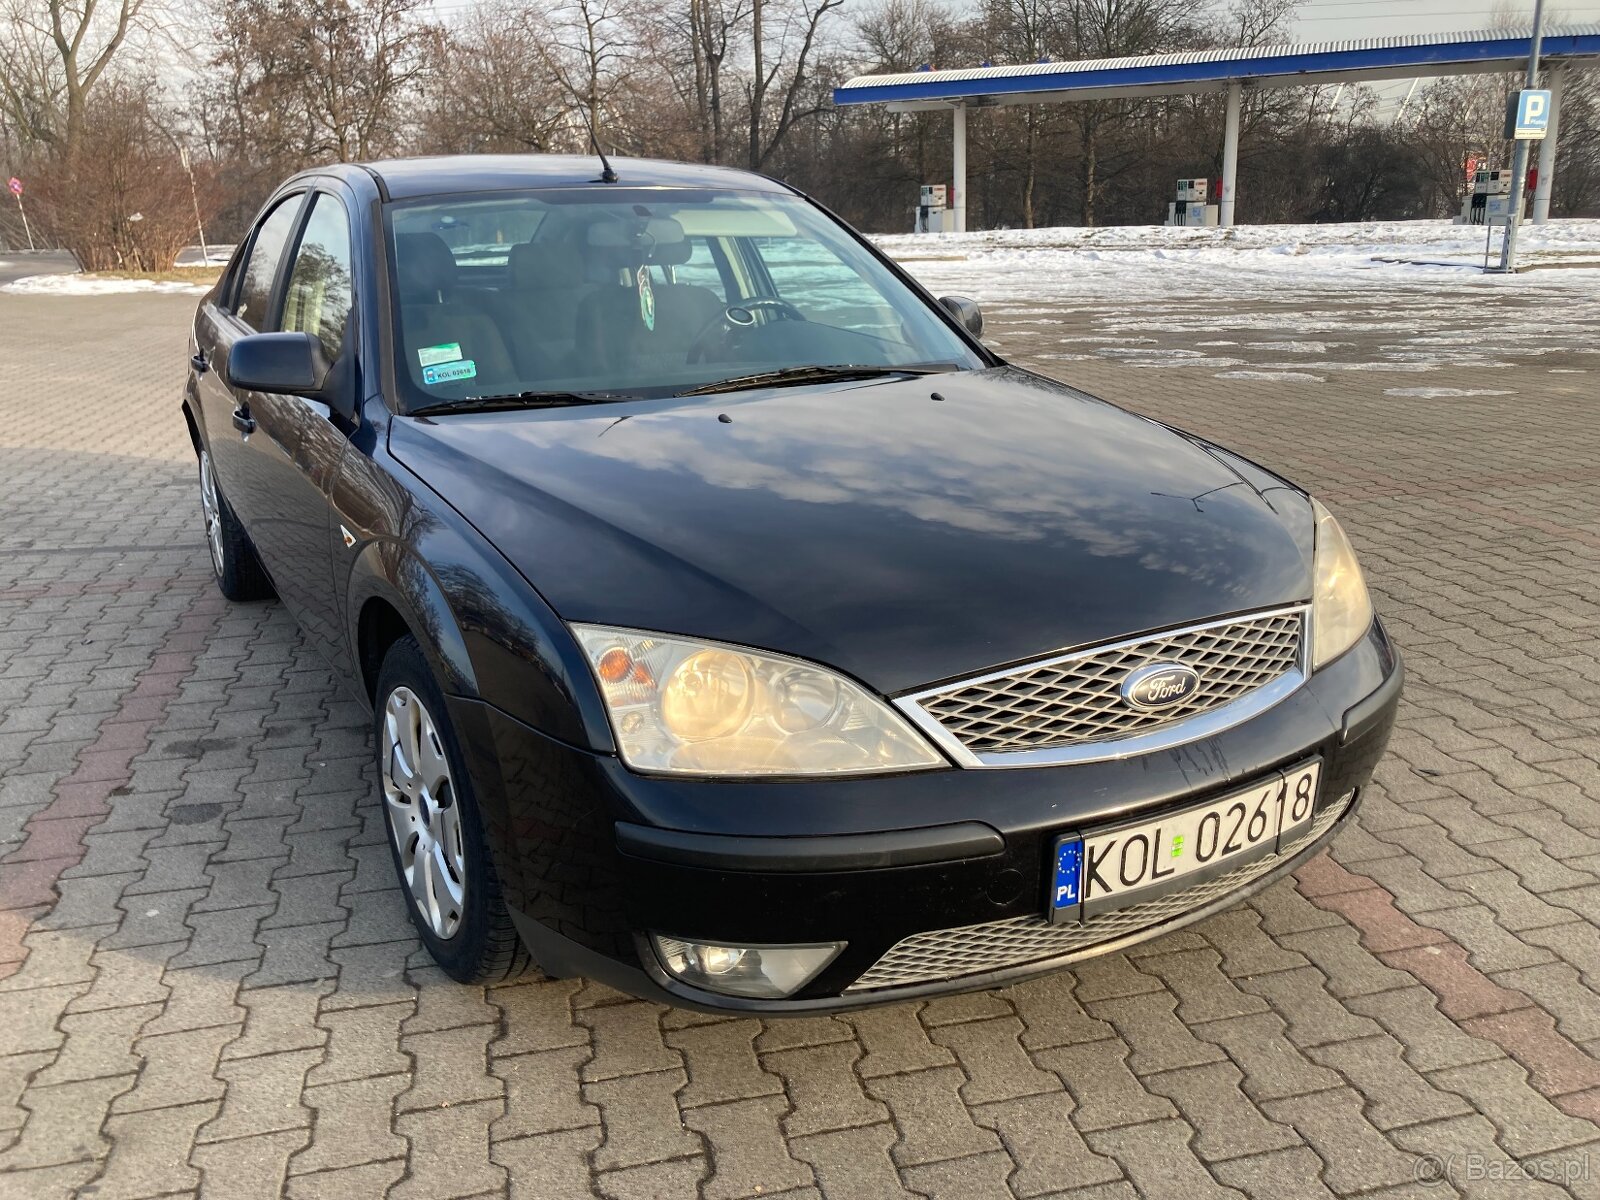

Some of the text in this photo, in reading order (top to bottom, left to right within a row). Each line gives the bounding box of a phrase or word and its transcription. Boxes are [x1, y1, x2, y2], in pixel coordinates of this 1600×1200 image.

[1523, 95, 1545, 125] P
[1147, 674, 1187, 702] Ford
[1085, 773, 1313, 898] KOL 02618
[1056, 885, 1076, 901] PL
